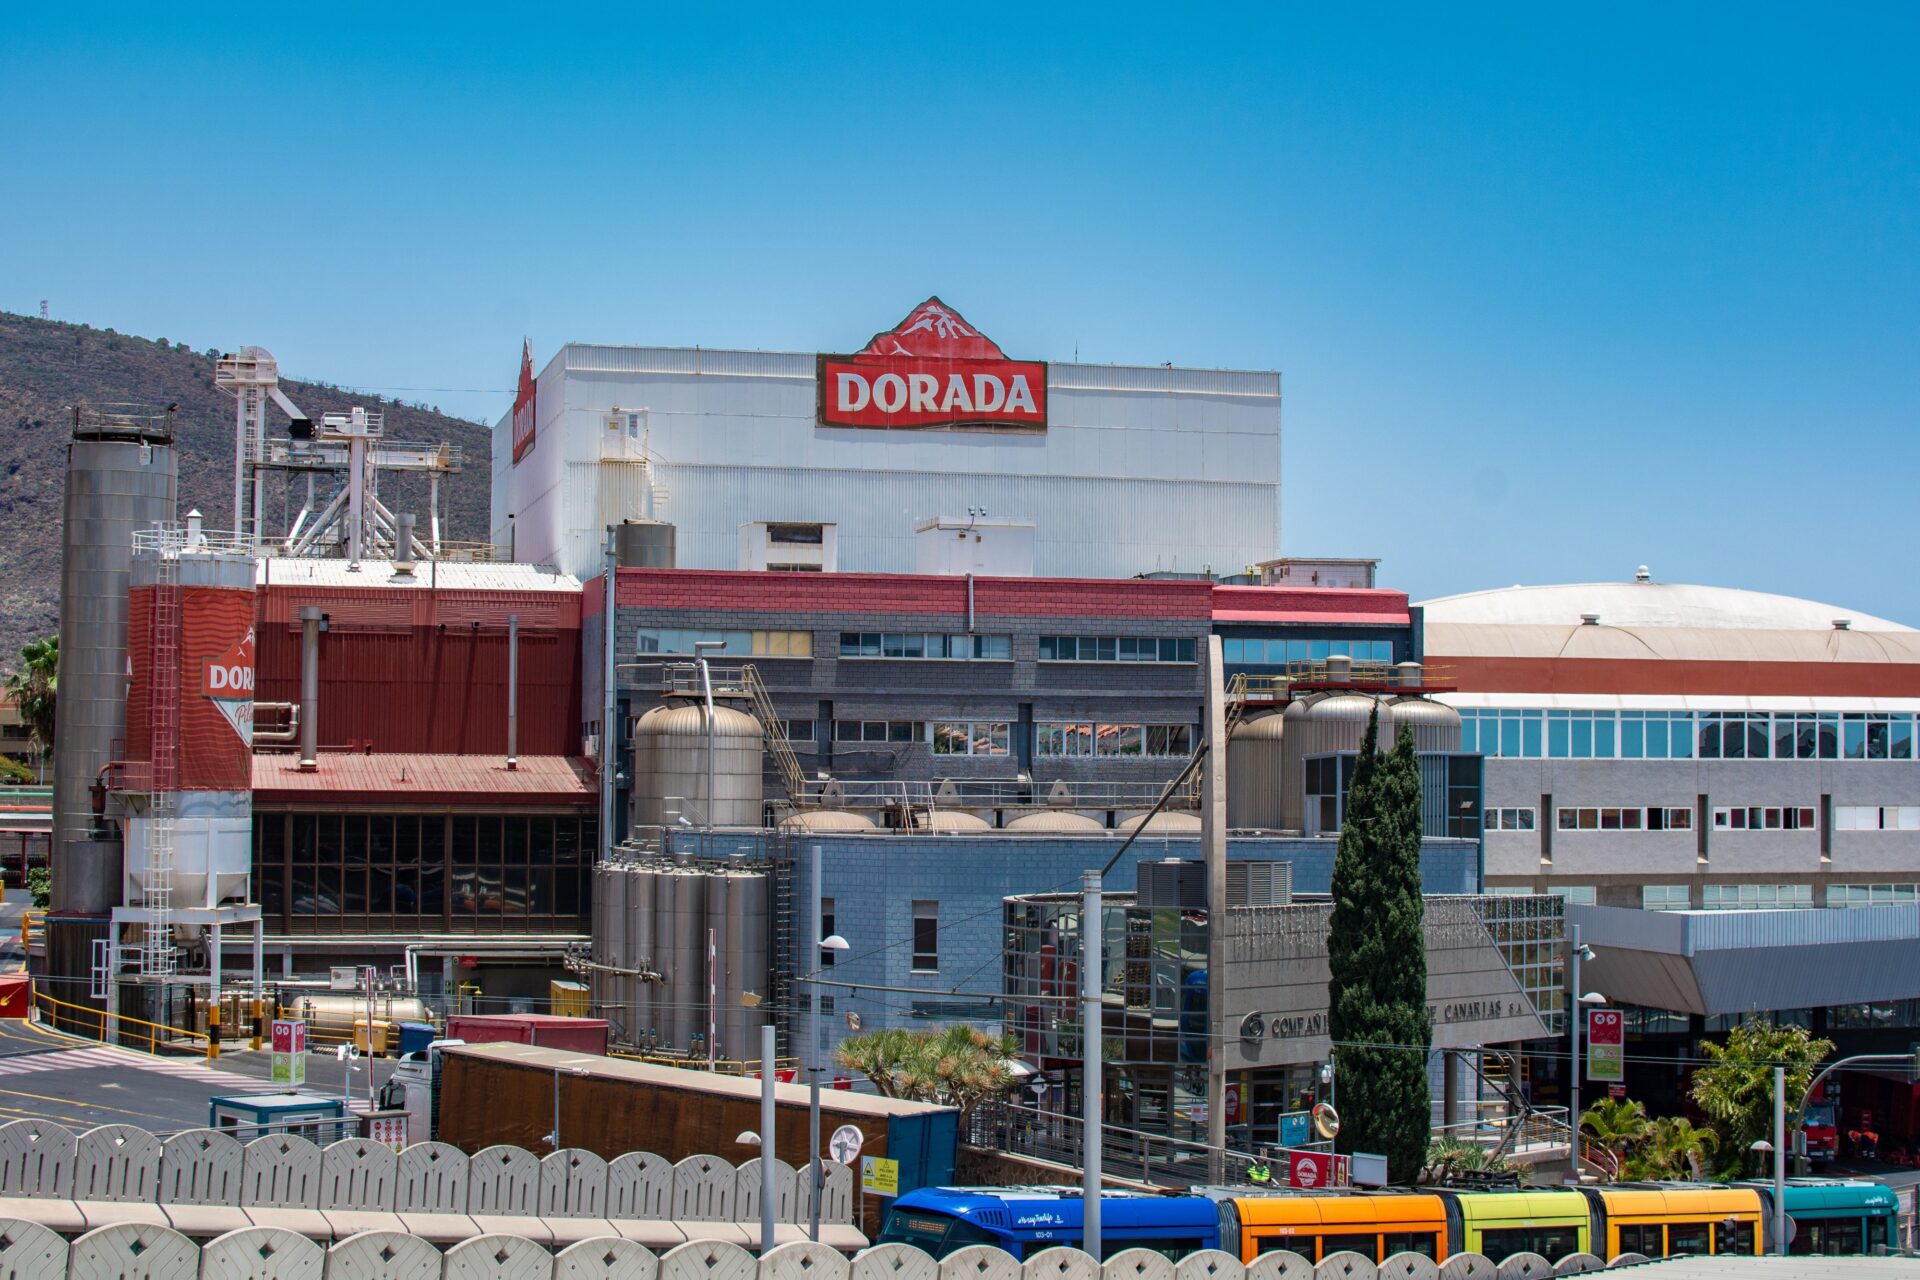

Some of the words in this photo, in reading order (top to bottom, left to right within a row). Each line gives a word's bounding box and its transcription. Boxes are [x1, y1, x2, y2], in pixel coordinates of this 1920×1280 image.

[836, 372, 1038, 413] DORADA
[1271, 1013, 1328, 1038] COMPAÑI
[1444, 1000, 1502, 1020] CANARIAS
[1035, 1231, 1053, 1239] 103-01
